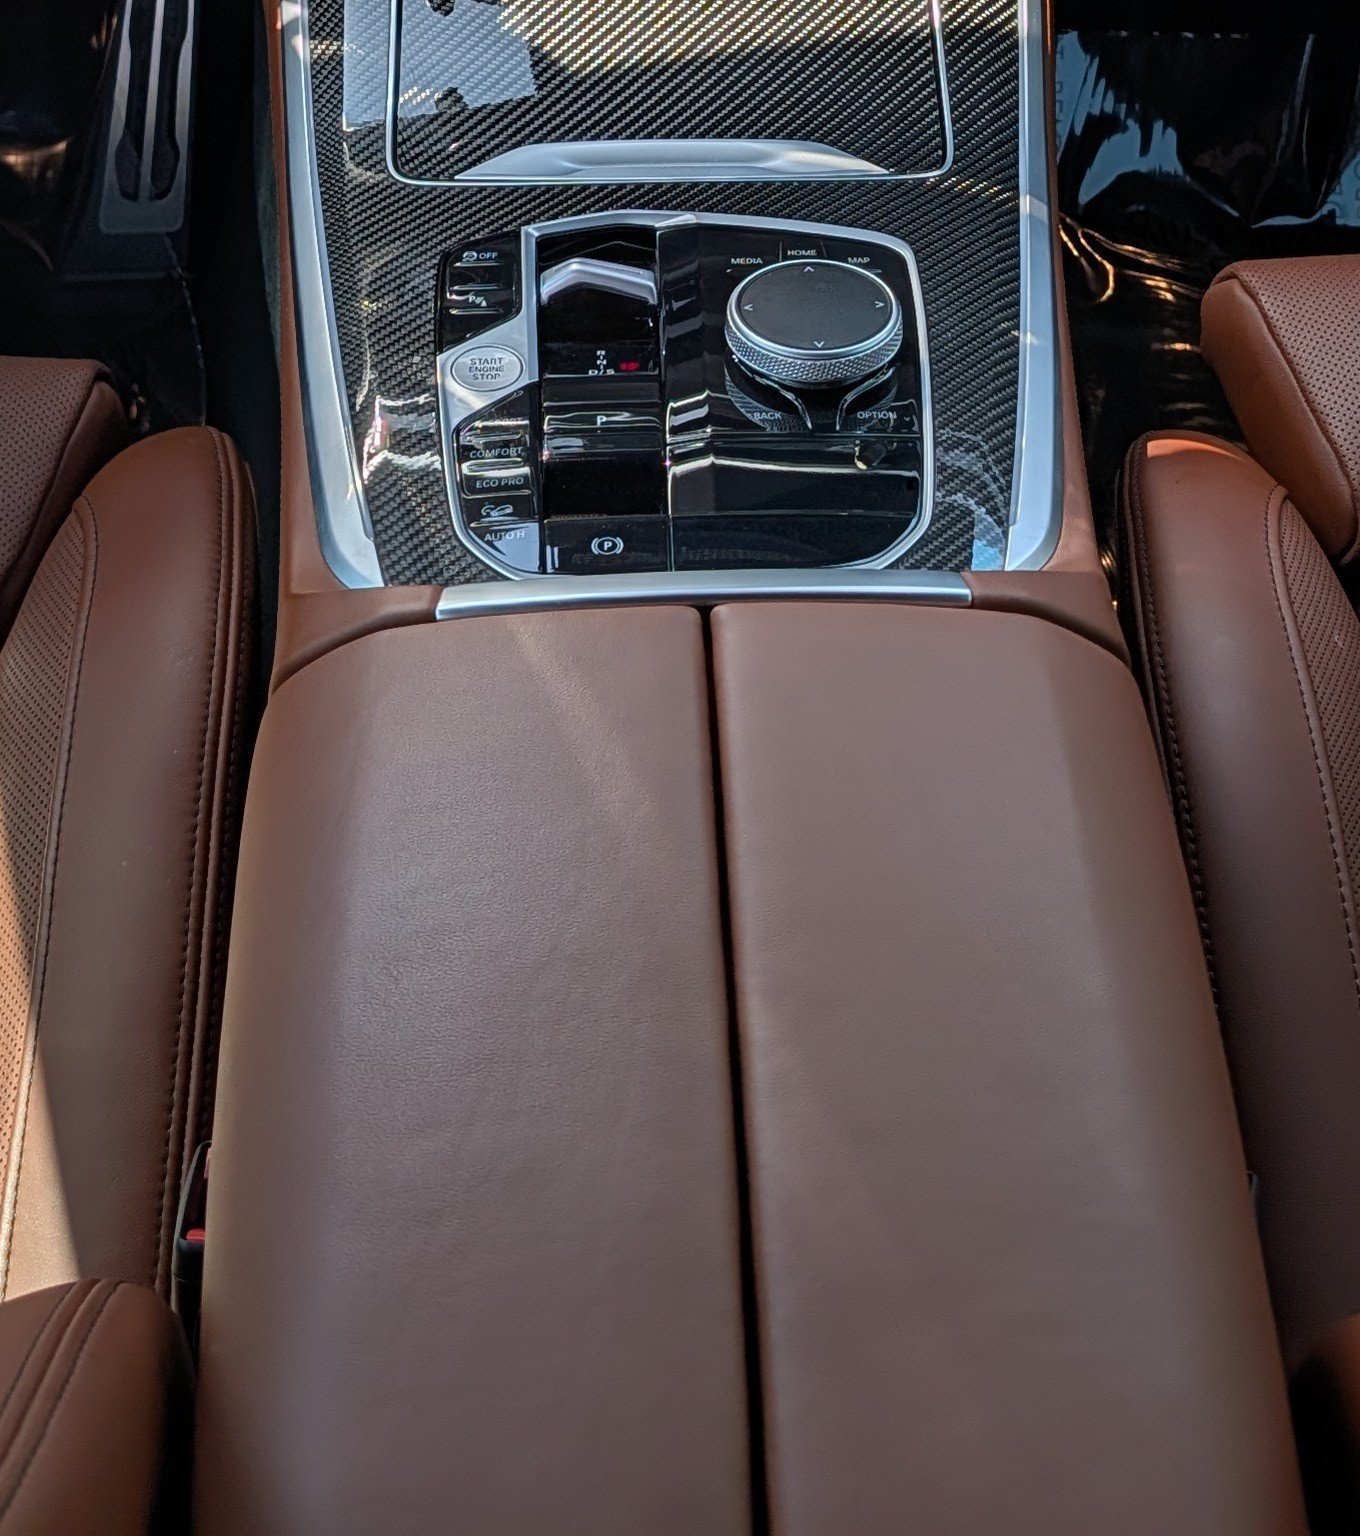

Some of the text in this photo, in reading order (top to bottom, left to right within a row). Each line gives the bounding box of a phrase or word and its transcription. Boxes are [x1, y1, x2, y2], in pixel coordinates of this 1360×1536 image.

[478, 251, 498, 260] OFF
[787, 248, 818, 257] HOME
[730, 256, 764, 265] MEDIA
[848, 256, 871, 265] MAP
[469, 356, 504, 366] START
[468, 365, 505, 373] ENGINE
[472, 372, 501, 381] STOP
[596, 414, 607, 426] P
[753, 411, 783, 421] BACK
[857, 410, 898, 421] OPTION
[469, 446, 524, 459] COMFORT
[475, 477, 524, 489] ECO PRO
[484, 531, 515, 542] AUTO
